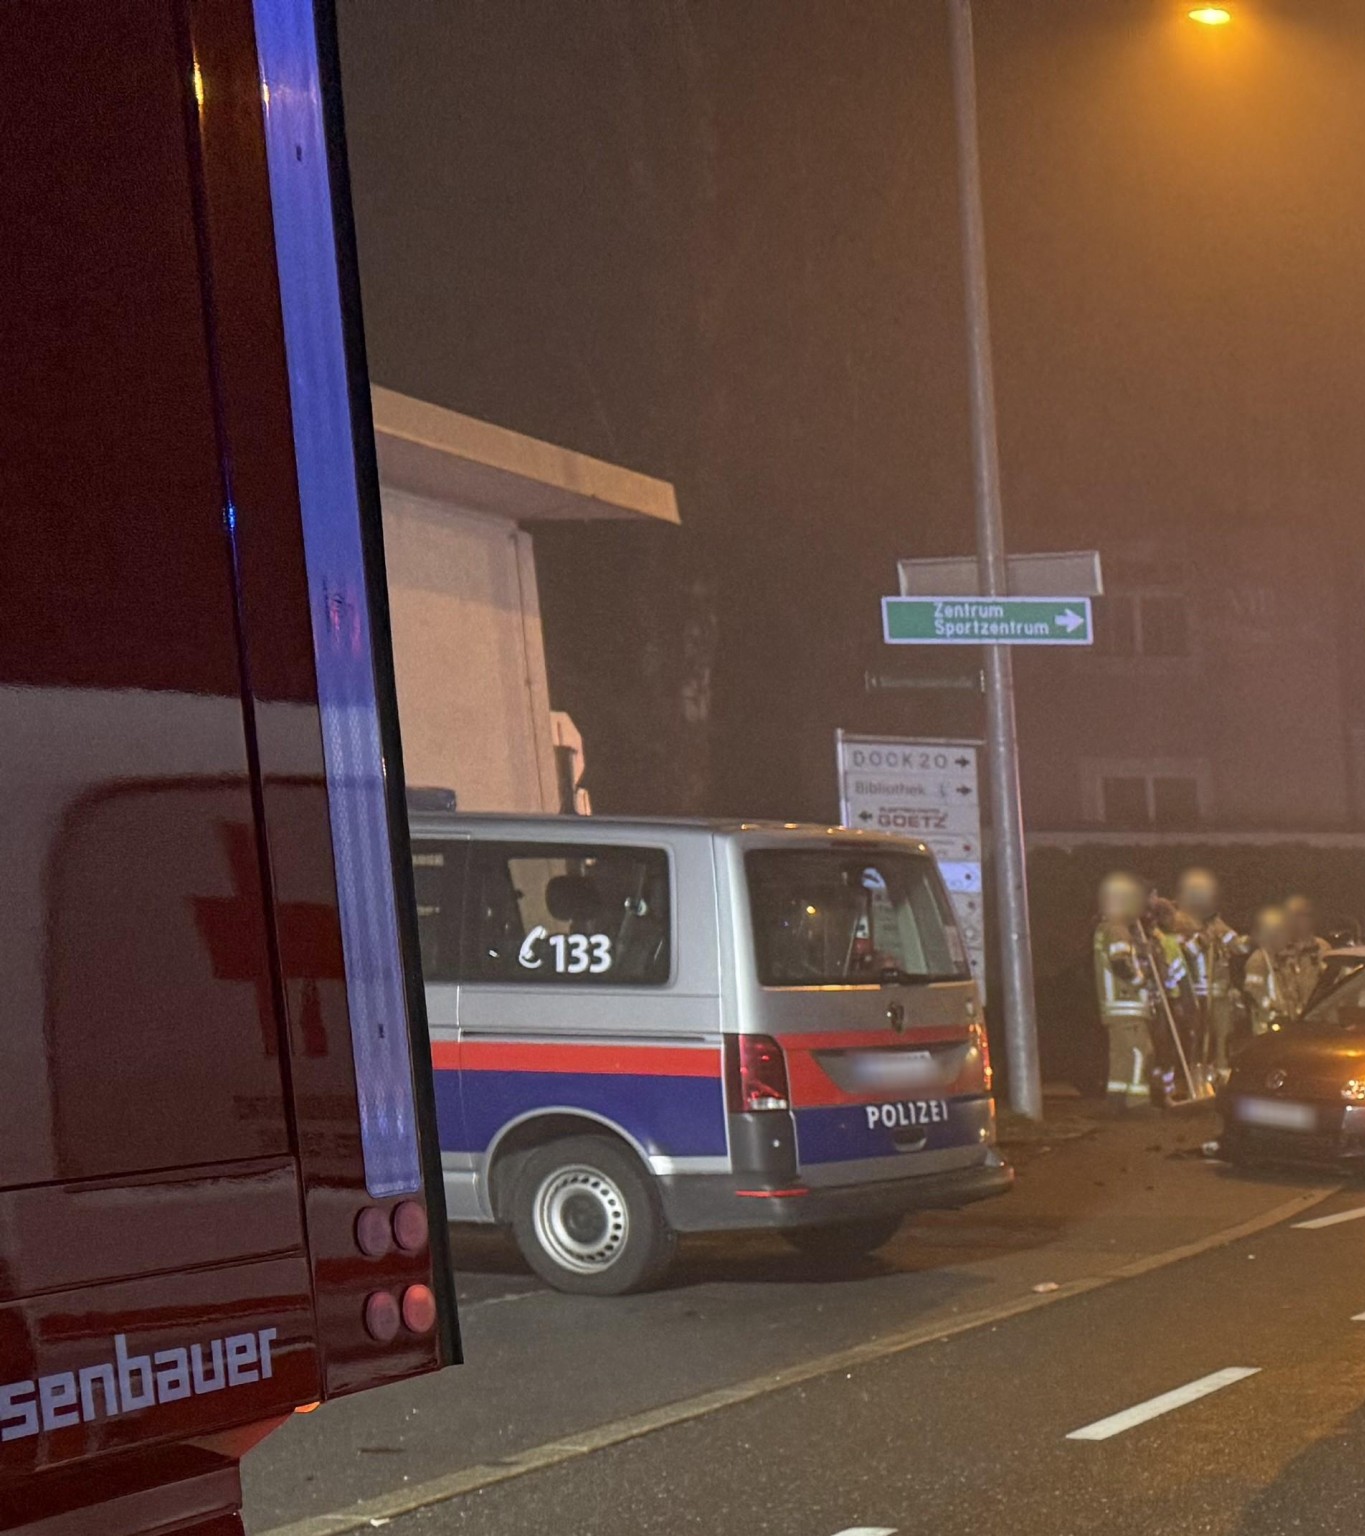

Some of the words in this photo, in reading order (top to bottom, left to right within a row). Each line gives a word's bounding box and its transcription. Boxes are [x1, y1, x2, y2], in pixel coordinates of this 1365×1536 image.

[933, 603, 1004, 618] Zentrum
[934, 620, 1050, 637] Sportzentrum
[855, 780, 926, 797] Bibliothek
[878, 814, 948, 829] GOETZ
[548, 934, 612, 974] 133
[864, 1100, 949, 1130] POLIZEI
[0, 1327, 277, 1441] senbauer
